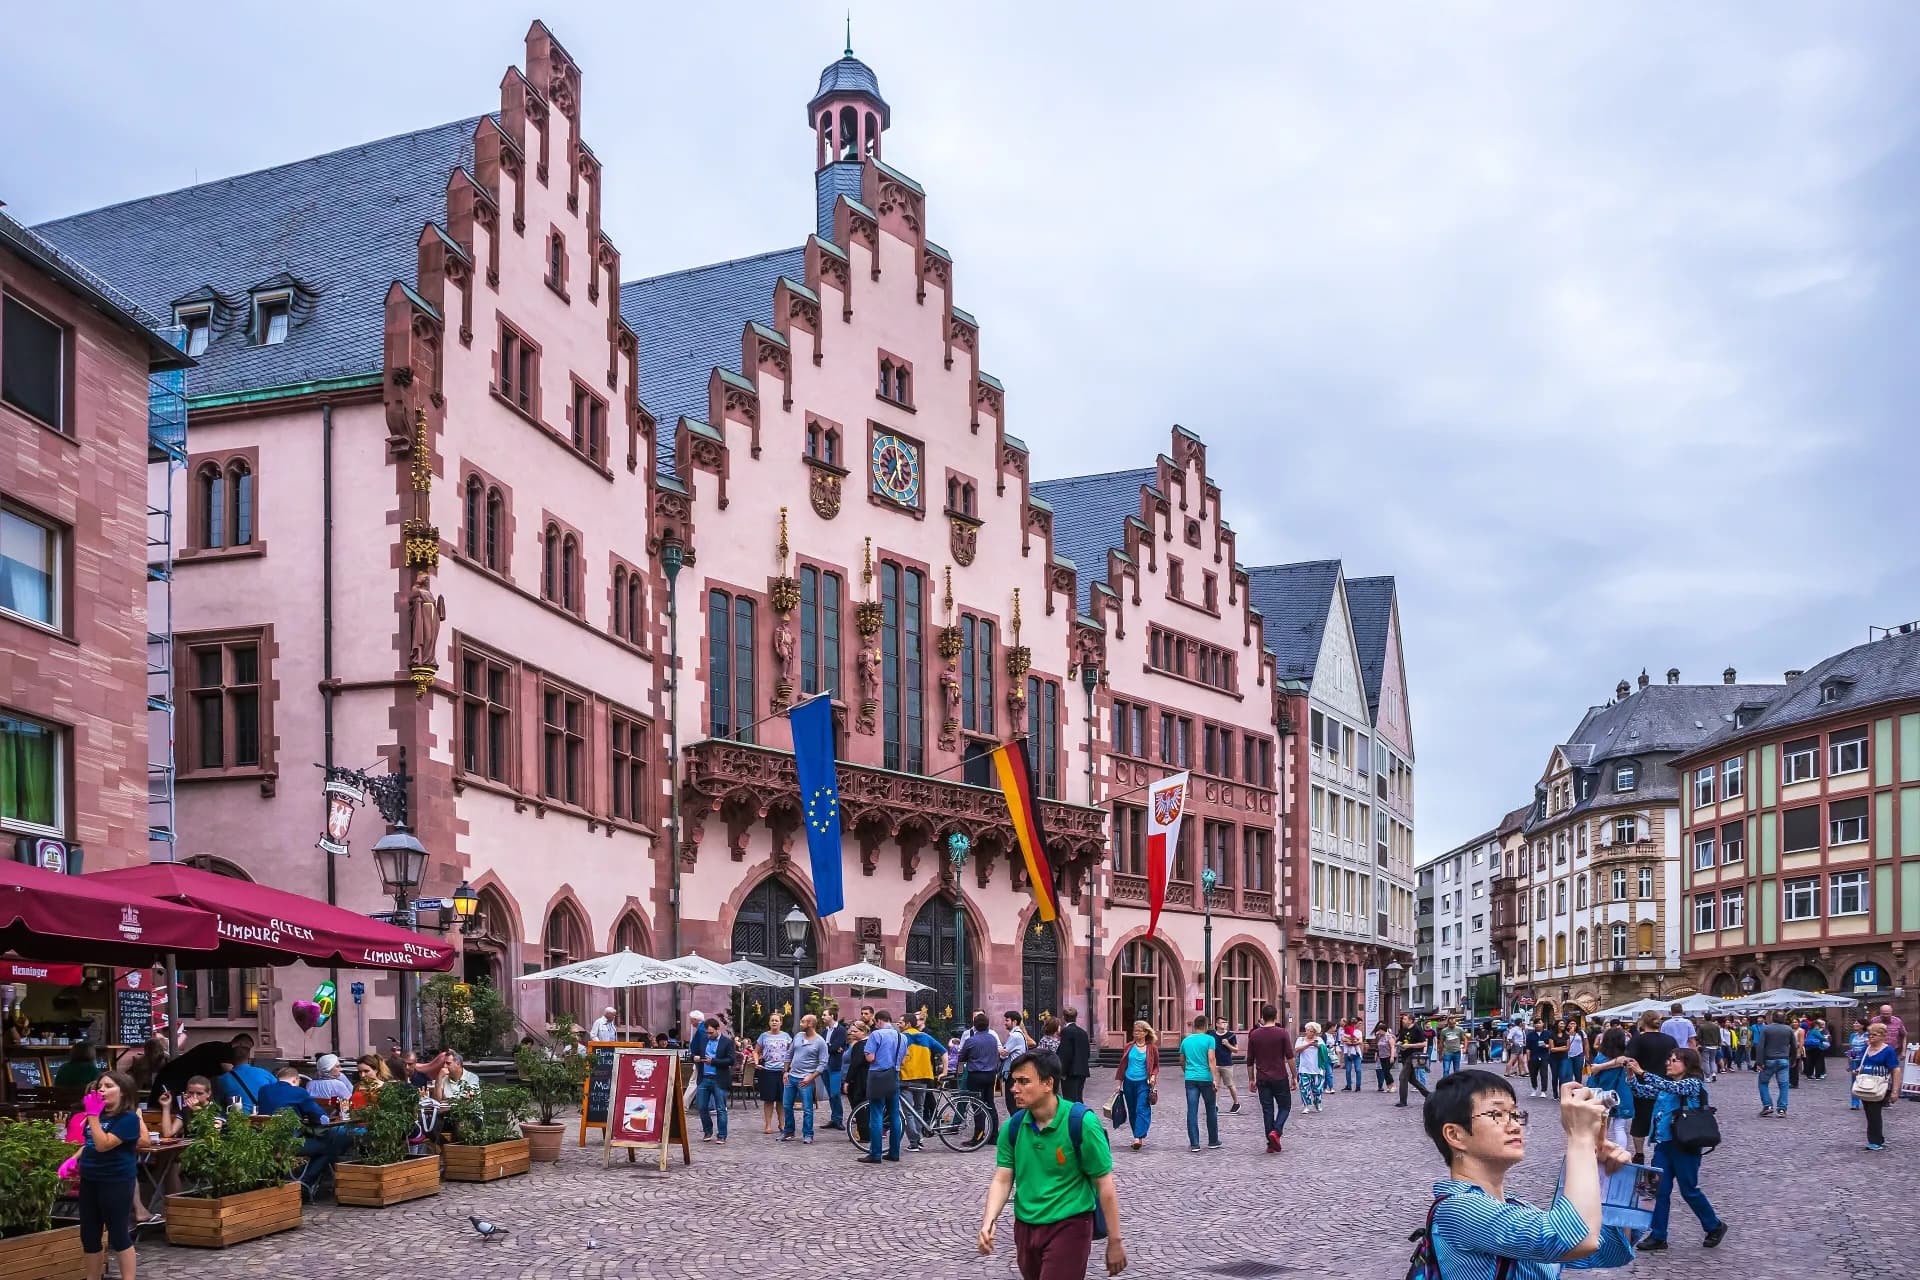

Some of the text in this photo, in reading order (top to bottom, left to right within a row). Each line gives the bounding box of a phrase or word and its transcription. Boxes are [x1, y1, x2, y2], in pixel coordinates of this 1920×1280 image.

[217, 920, 280, 943] LIMPURG
[270, 919, 314, 940] ALTEN
[364, 949, 413, 964] LIMPURG
[404, 943, 441, 958] ALTEN
[12, 965, 48, 978] Henninger
[1861, 970, 1874, 983] U
